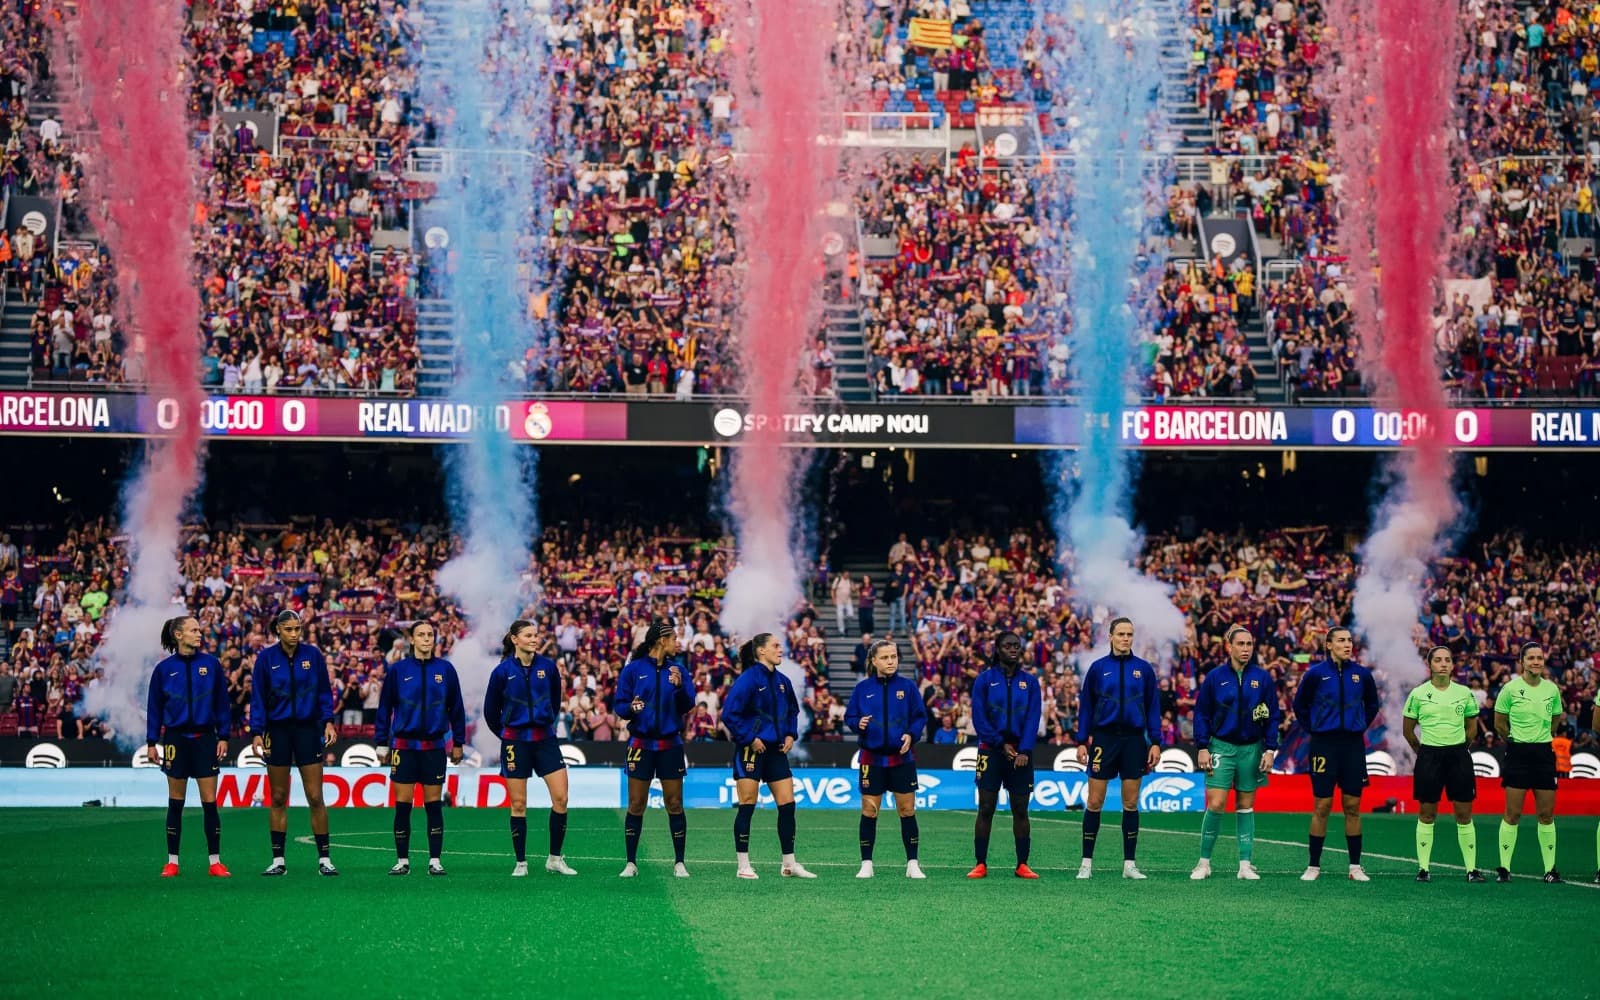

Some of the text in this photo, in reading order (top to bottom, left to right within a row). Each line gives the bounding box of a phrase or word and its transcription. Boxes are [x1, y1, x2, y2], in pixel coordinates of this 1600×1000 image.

[0, 397, 110, 427] RCELONA
[157, 398, 179, 430] 0
[282, 400, 306, 432] 0
[359, 402, 415, 432] REAL
[743, 414, 929, 433] SPOTIFY CAMP NOU
[1121, 411, 1149, 440] FC
[1154, 410, 1287, 441] BARCELONA
[1331, 410, 1356, 442] 0
[1455, 410, 1478, 442] 0
[1531, 412, 1587, 442] REAL
[262, 732, 271, 748] 6
[164, 744, 176, 760] 10
[505, 745, 515, 762] 3
[1092, 746, 1103, 763] 2
[861, 764, 868, 778] 9
[1310, 756, 1326, 773] 12
[1149, 797, 1192, 812] Liga F
